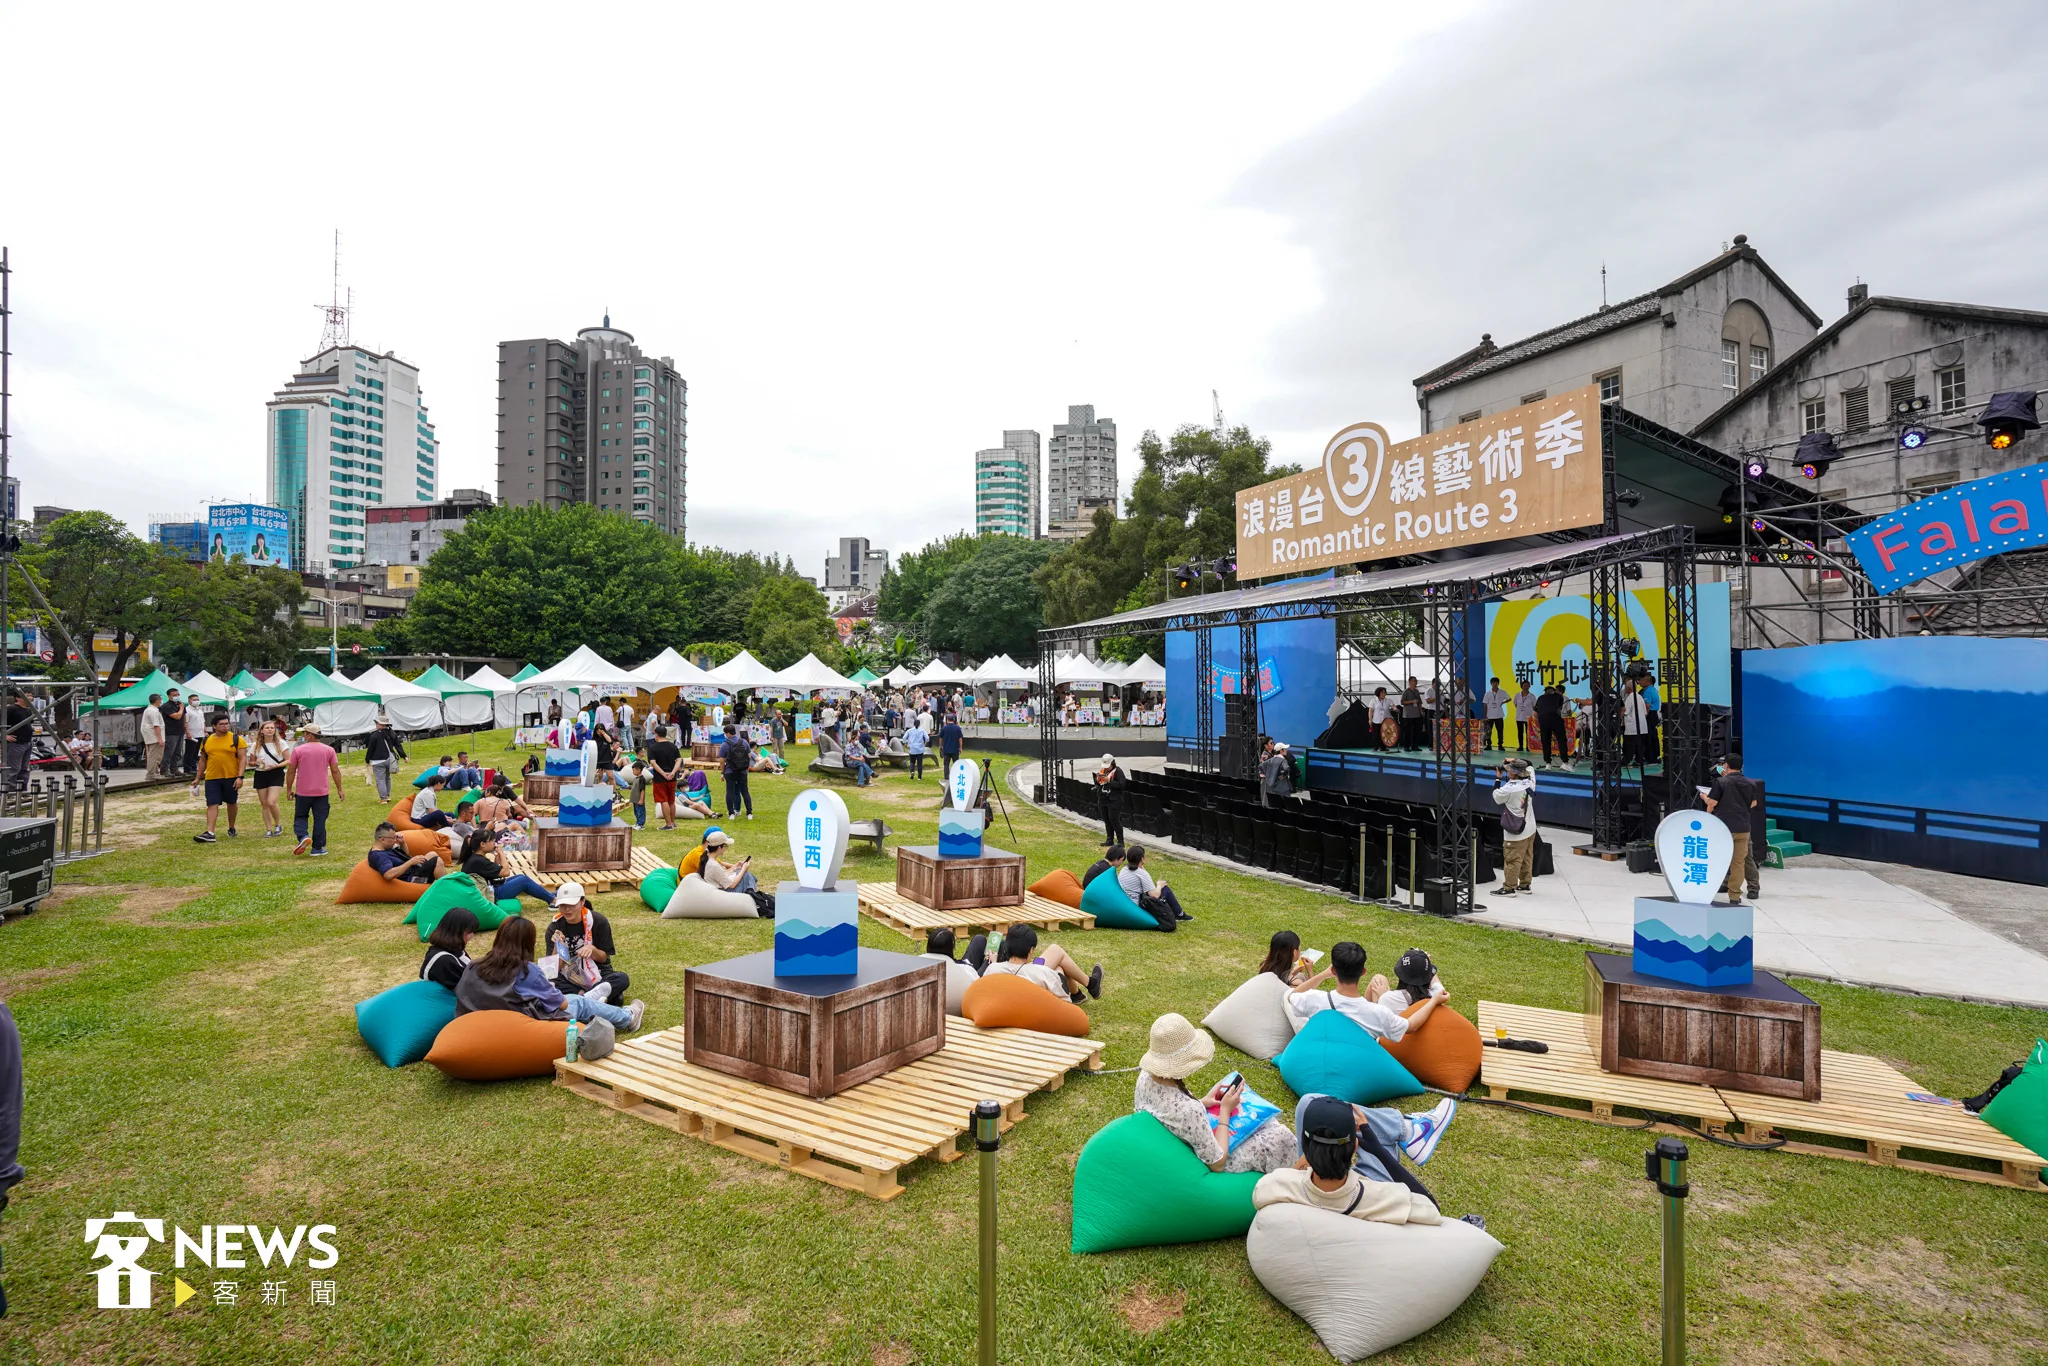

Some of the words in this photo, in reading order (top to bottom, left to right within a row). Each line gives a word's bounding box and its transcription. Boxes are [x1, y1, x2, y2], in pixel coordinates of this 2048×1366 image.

[212, 507, 247, 517] 台北市中心
[252, 507, 287, 521] 台北市中心
[1272, 517, 1386, 564] Romantic
[1395, 501, 1490, 542] Route
[1498, 488, 1518, 523] 3
[1871, 479, 2048, 573] Fala
[957, 774, 966, 801] 北埔
[804, 817, 821, 869] 關西
[1683, 835, 1709, 885] 龍潭
